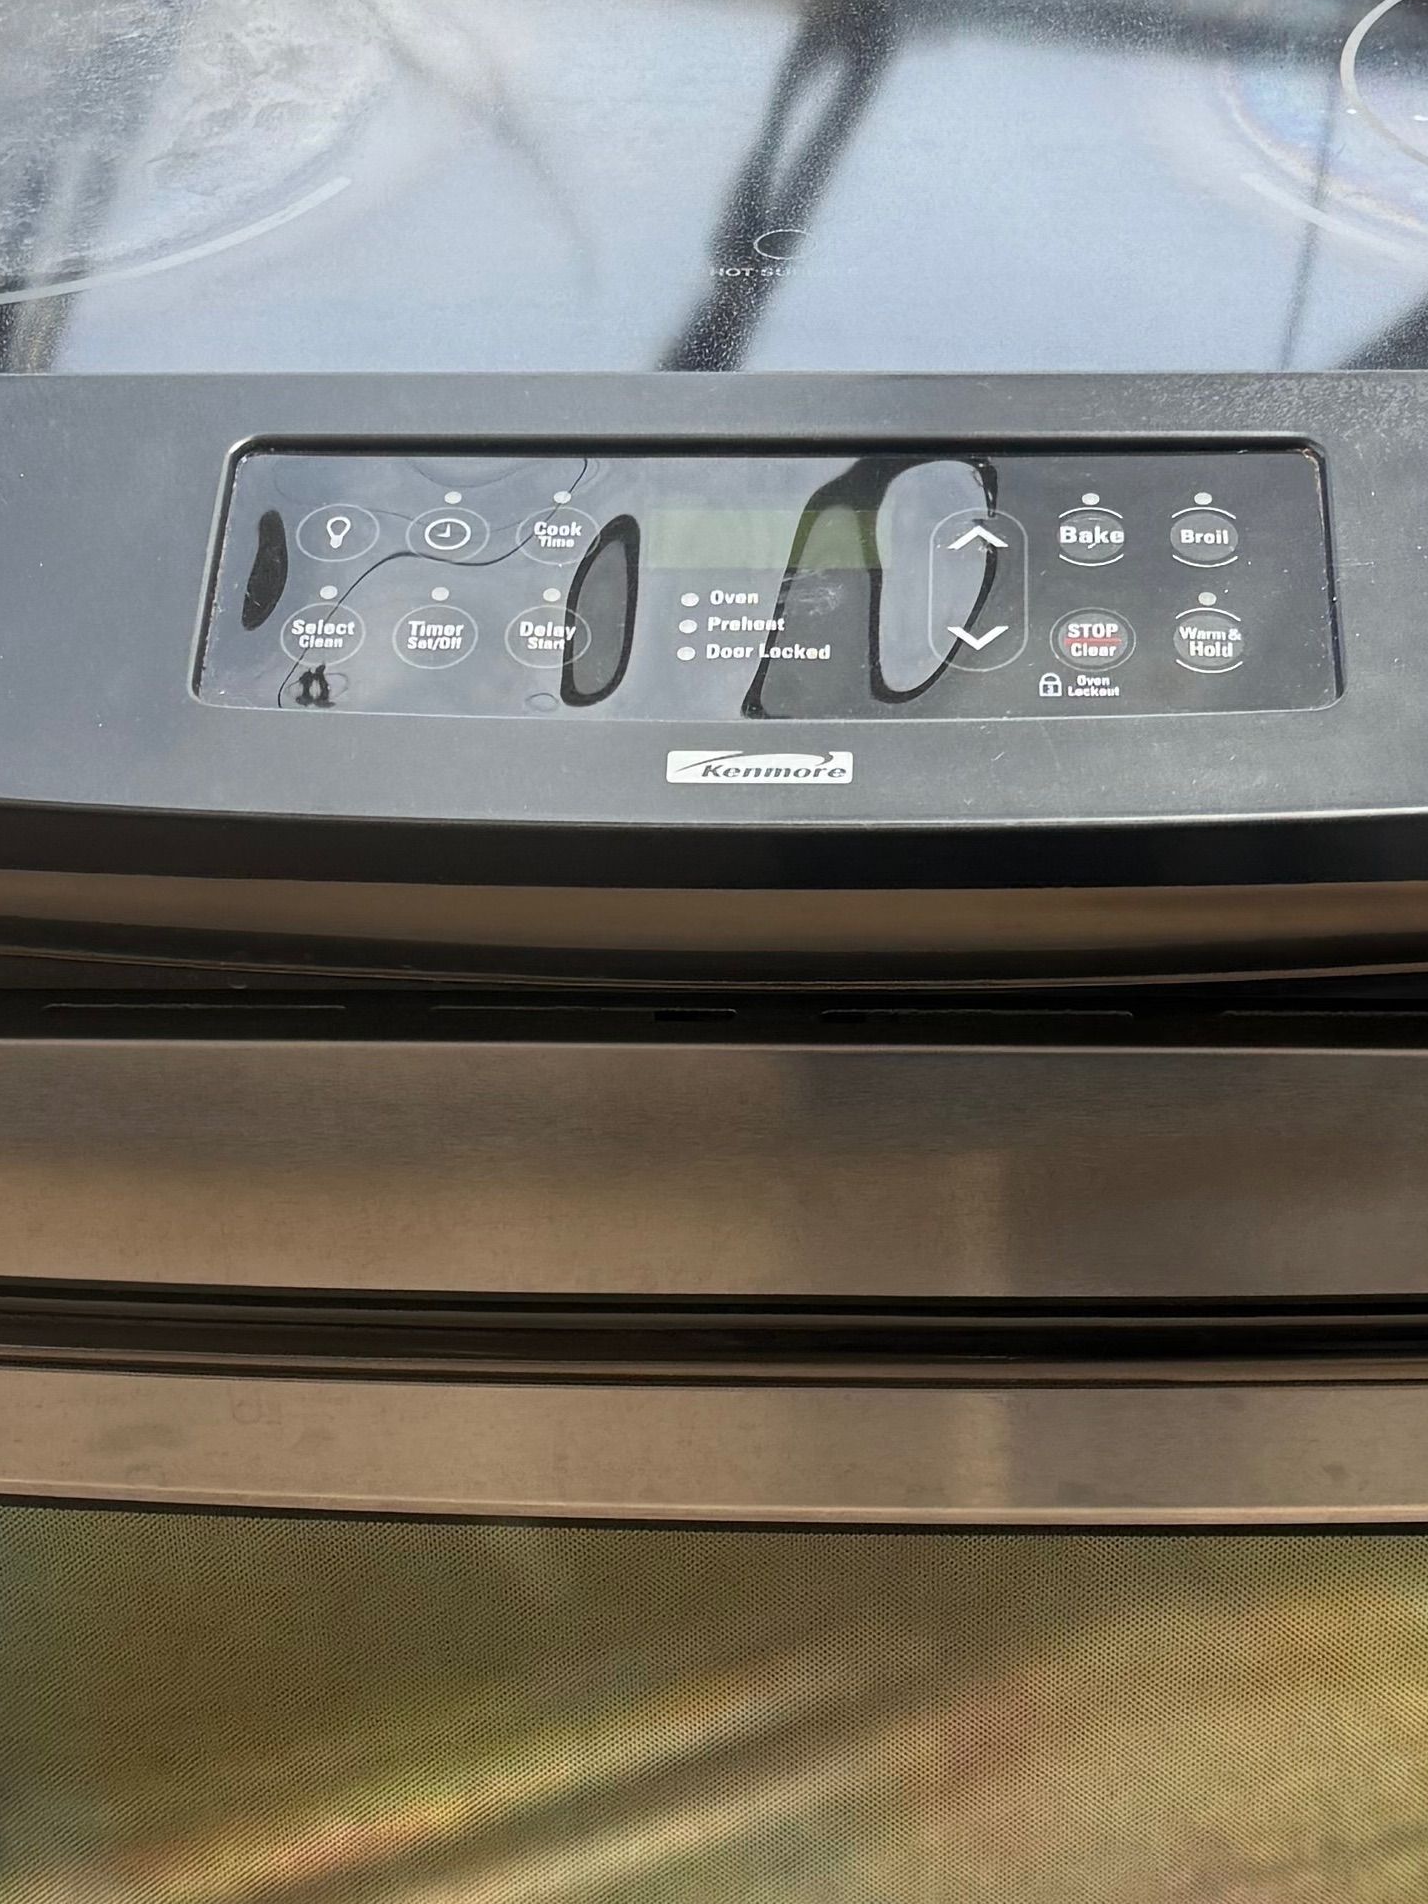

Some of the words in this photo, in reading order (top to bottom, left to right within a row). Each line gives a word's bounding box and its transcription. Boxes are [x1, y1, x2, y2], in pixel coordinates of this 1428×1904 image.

[534, 521, 583, 536] Cook
[1059, 525, 1125, 544] Bake
[538, 535, 575, 548] Time
[1180, 529, 1230, 544] Broil
[709, 589, 760, 605] Oven
[291, 620, 355, 636] Select
[408, 620, 464, 637] Timer
[519, 621, 577, 641] Delay
[707, 616, 786, 631] Preheat
[1067, 623, 1119, 638] STOP
[1179, 626, 1226, 641] Warm
[1228, 628, 1242, 641] &
[299, 636, 343, 648] Clean
[407, 637, 463, 651] Set/Off
[527, 637, 565, 650] Start
[706, 643, 754, 659] Door
[759, 643, 831, 660] Locked
[1070, 643, 1117, 657] Clear
[1189, 642, 1234, 658] Hold
[1076, 674, 1110, 686] Oven
[1068, 685, 1120, 697] Lockout
[700, 763, 847, 779] Kenmore
